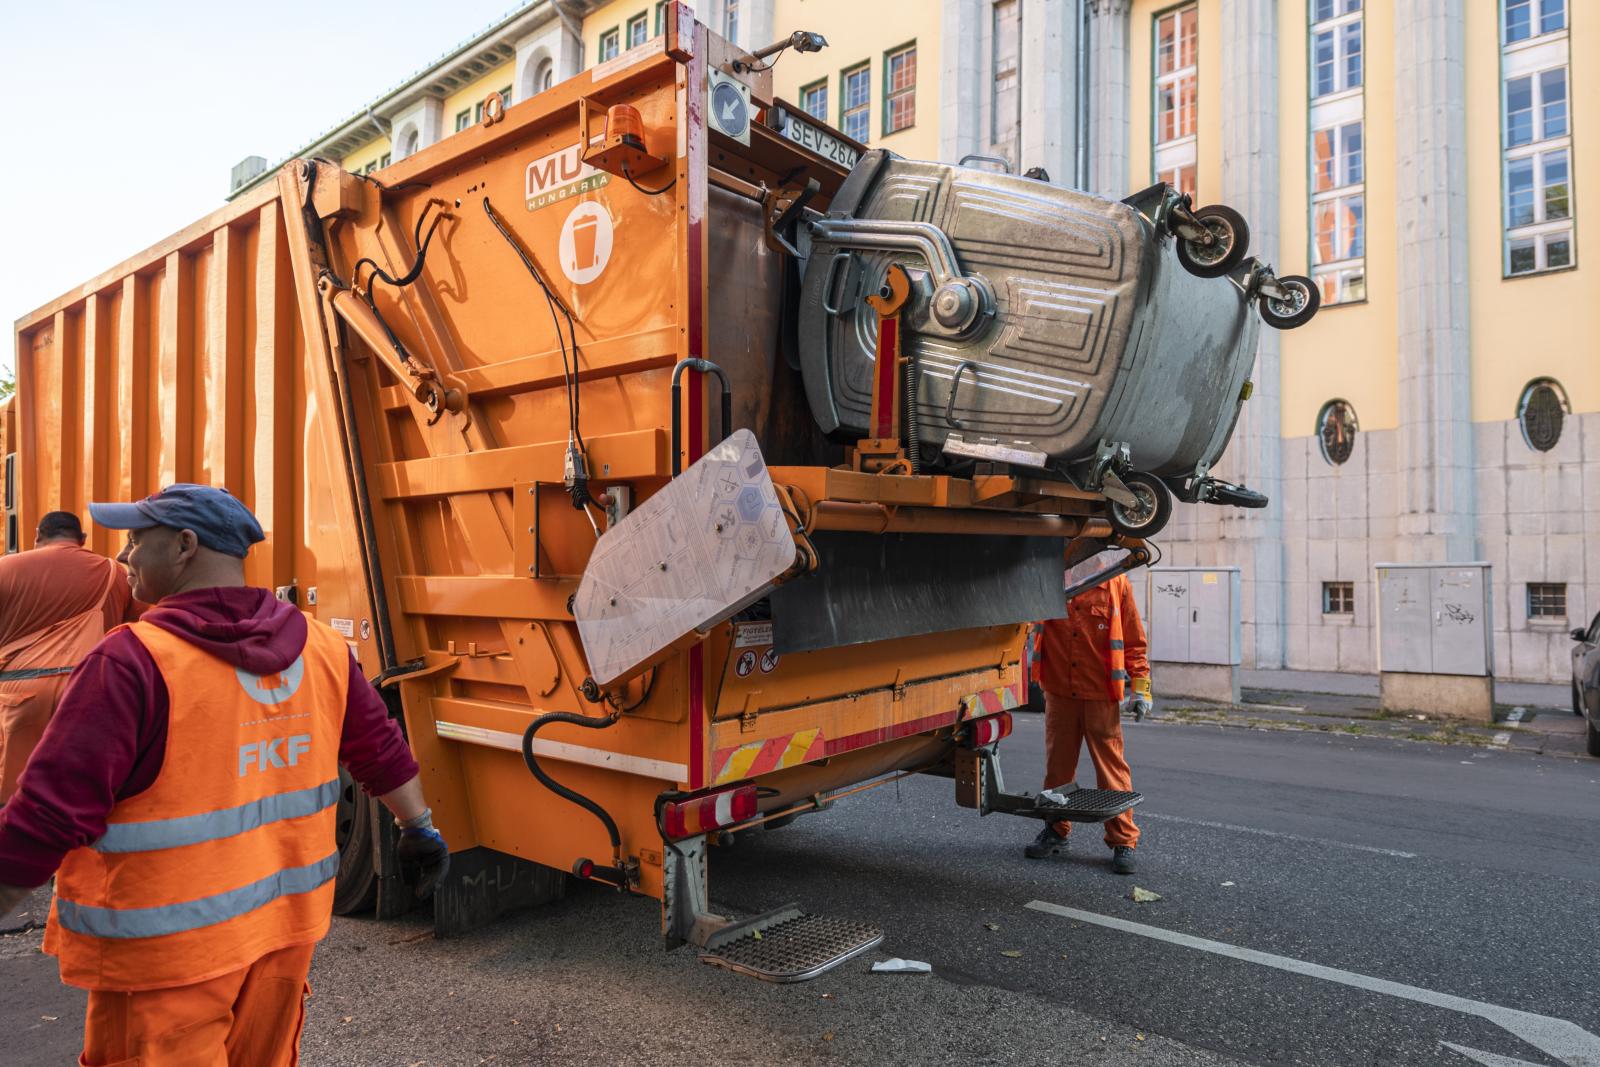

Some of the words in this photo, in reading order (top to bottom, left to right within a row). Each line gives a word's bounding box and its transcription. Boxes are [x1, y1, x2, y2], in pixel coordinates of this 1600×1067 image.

[791, 119, 854, 169] SEV-264
[529, 140, 605, 195] MU
[742, 624, 772, 635] FIGYELE
[239, 734, 312, 777] FKF
